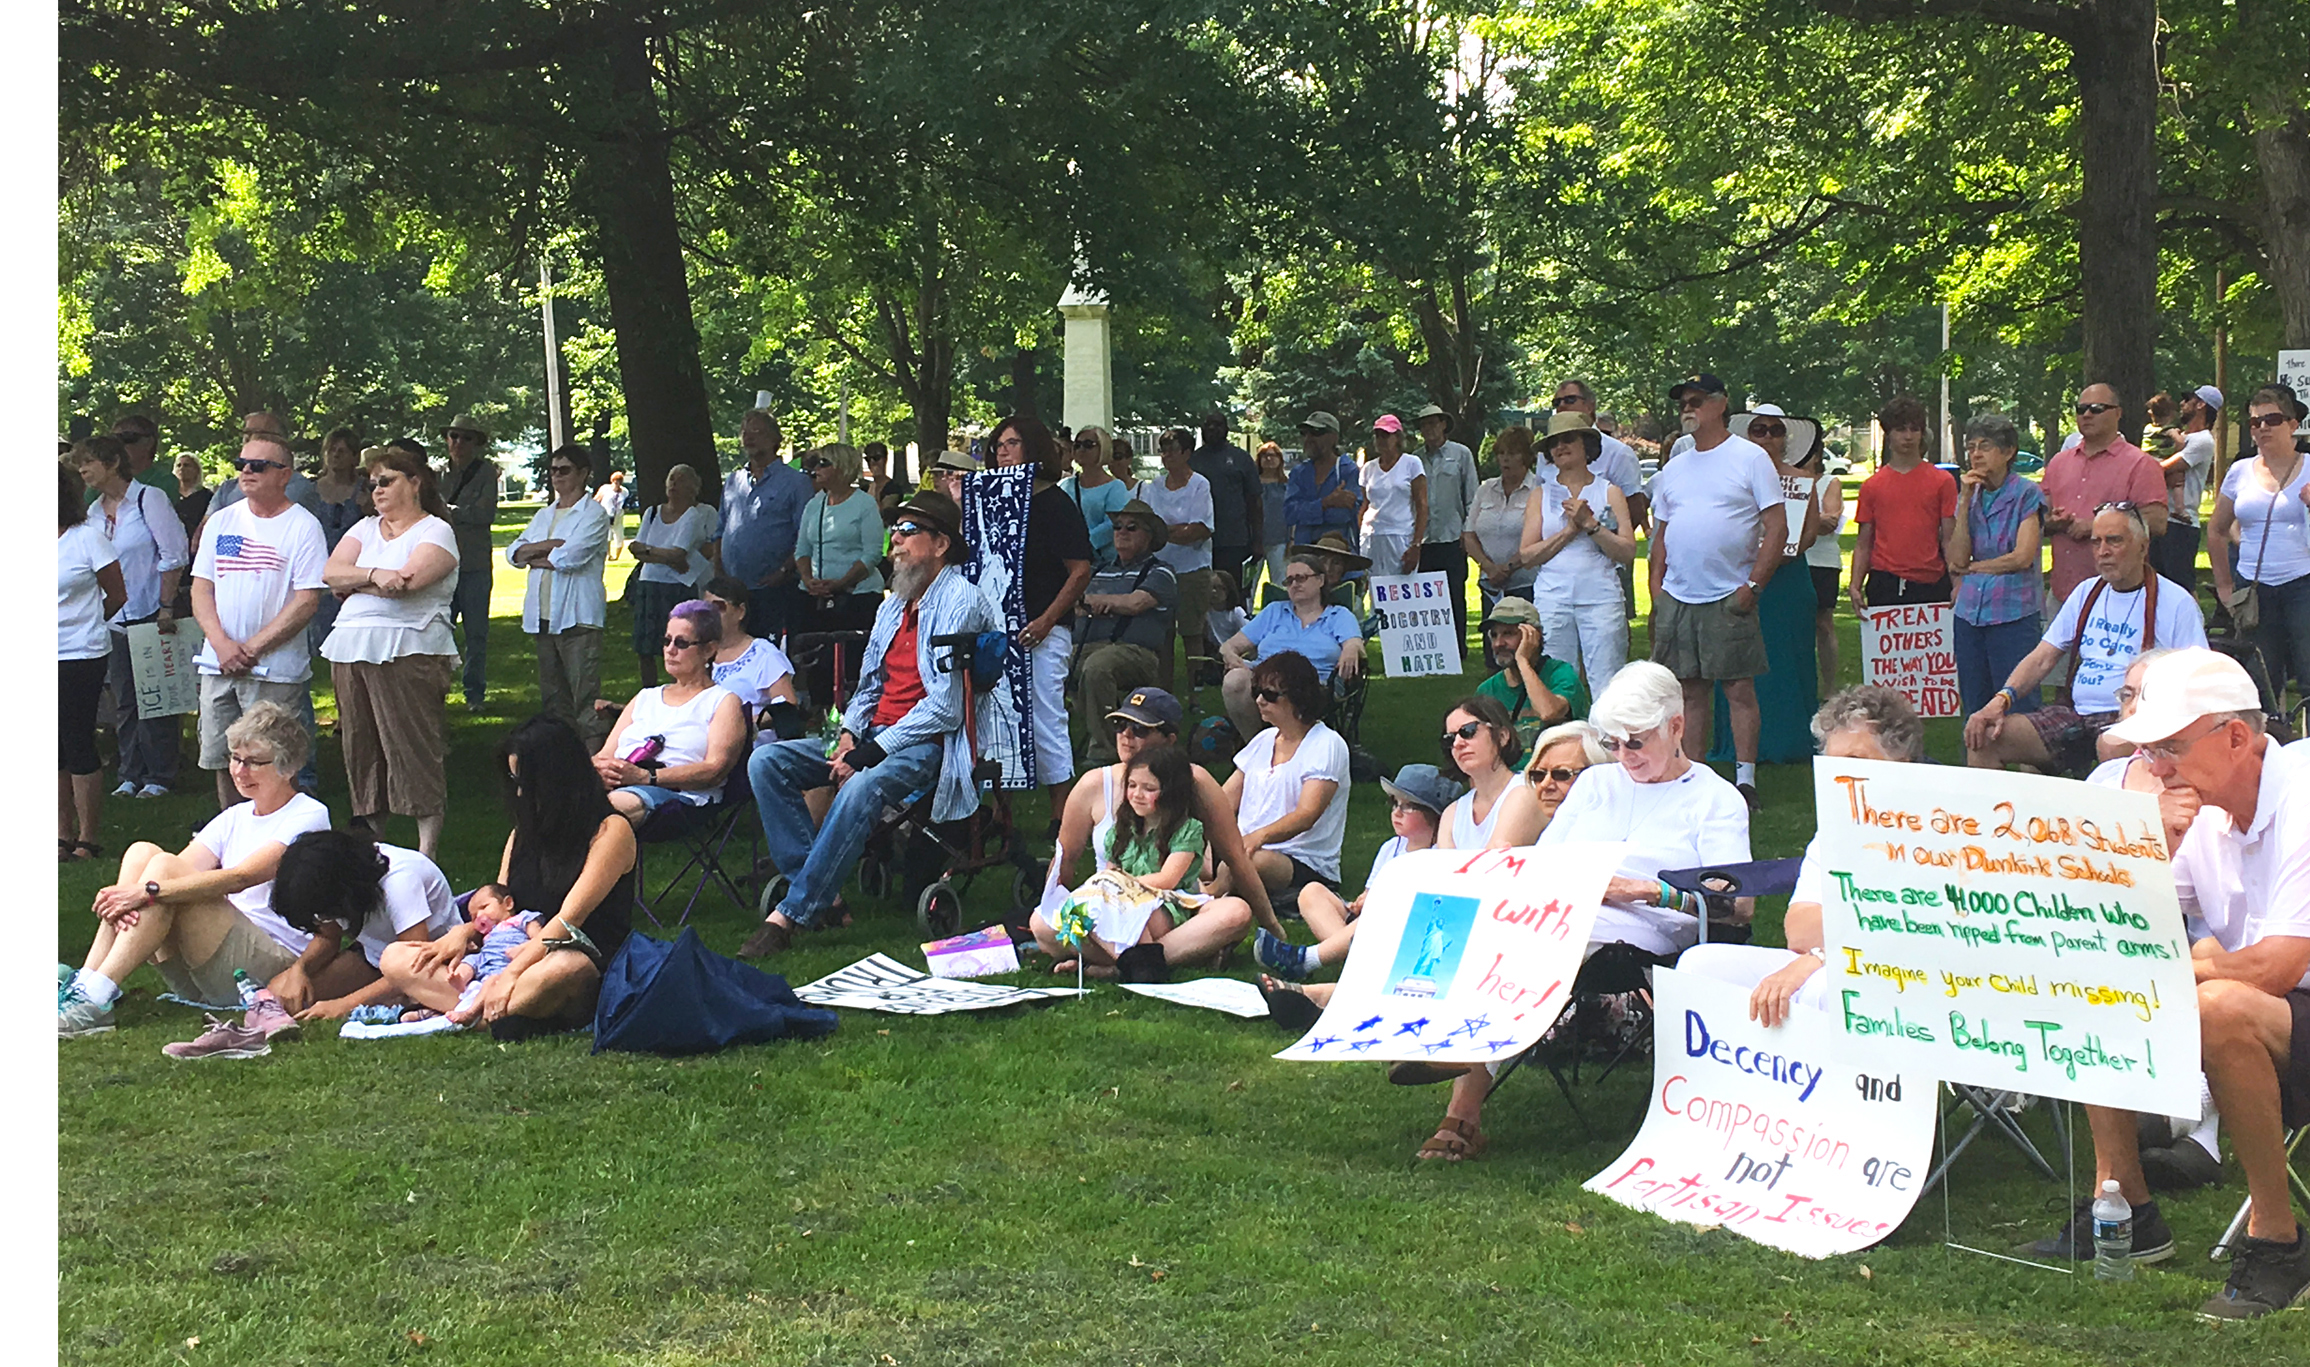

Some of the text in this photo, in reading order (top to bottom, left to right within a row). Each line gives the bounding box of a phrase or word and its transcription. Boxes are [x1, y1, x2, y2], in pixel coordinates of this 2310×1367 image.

[1376, 580, 1443, 602] RESIST
[1379, 607, 1450, 630] BIGOTRY
[1870, 603, 1951, 631] TREAT
[2089, 616, 2137, 639] I Really
[161, 639, 176, 678] HEART
[1403, 632, 1437, 651] AND
[1879, 628, 1943, 655] OTHERS
[2081, 634, 2137, 656] Do Care.
[1401, 653, 1445, 673] HATE
[1871, 652, 1957, 675] THE WAY YOU
[1922, 676, 1937, 686] to
[1940, 677, 1956, 687] be
[1901, 688, 1960, 715] EATED
[1834, 775, 2168, 862] There are 2,068 Students
[1452, 842, 1527, 878] I'm
[1912, 845, 1956, 867] our
[1961, 844, 2053, 878] Dunkirk
[2057, 854, 2135, 889] Schools
[1492, 898, 1574, 941] with
[1828, 870, 1898, 904] There
[1900, 887, 1943, 907] are
[2099, 900, 2150, 931] Who
[1852, 902, 1904, 933] have
[1901, 908, 1945, 937] been
[1945, 920, 2002, 948] ripped
[2003, 918, 2047, 947] from
[2116, 938, 2180, 960] arms!
[1475, 952, 1562, 1022] her!
[1841, 945, 1928, 994] Imagine
[1938, 969, 1983, 998] your
[2049, 979, 2161, 1022] missing!
[1841, 988, 2156, 1081] Families Belong Together!
[1685, 1009, 1902, 1103] Decency and
[1661, 1075, 1912, 1191] Compassion are
[1723, 1151, 1794, 1191] not
[1605, 1157, 1890, 1238] Partisan Issues
